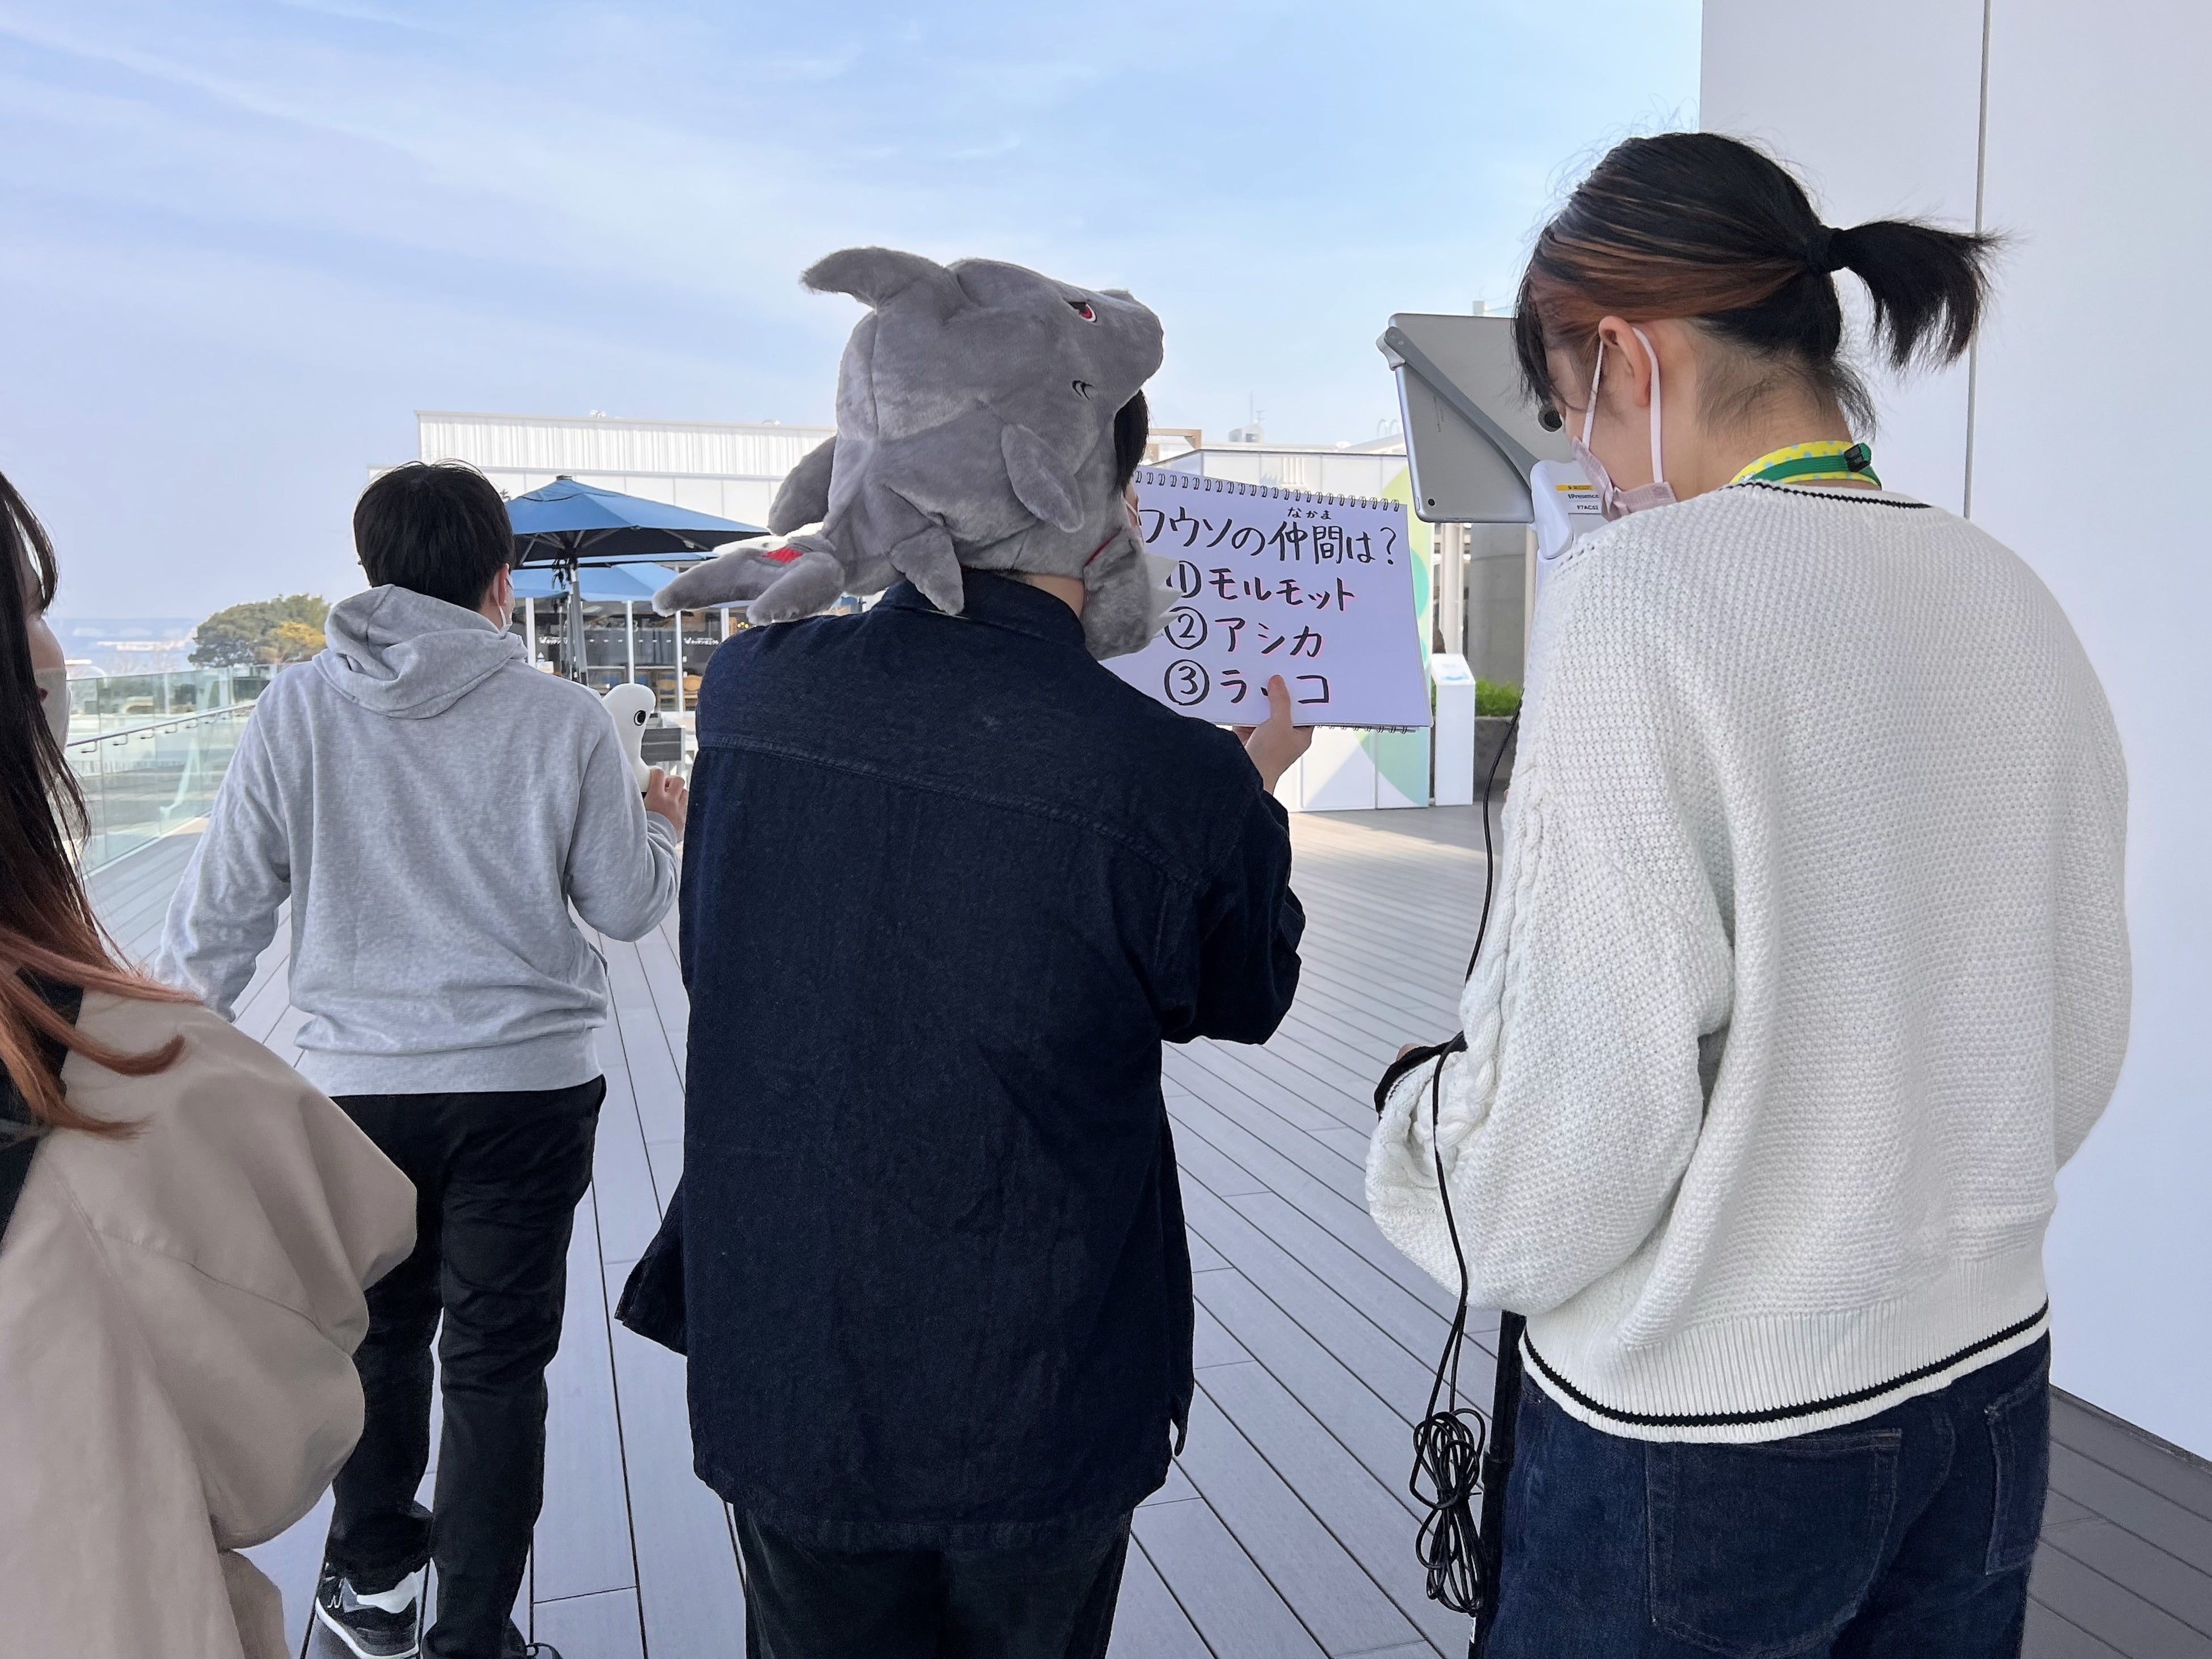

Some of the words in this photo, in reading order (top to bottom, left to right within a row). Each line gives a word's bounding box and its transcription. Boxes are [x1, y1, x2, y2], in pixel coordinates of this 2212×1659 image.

[1287, 506, 1332, 520] なかま
[1164, 659, 1330, 706] ③ラコ
